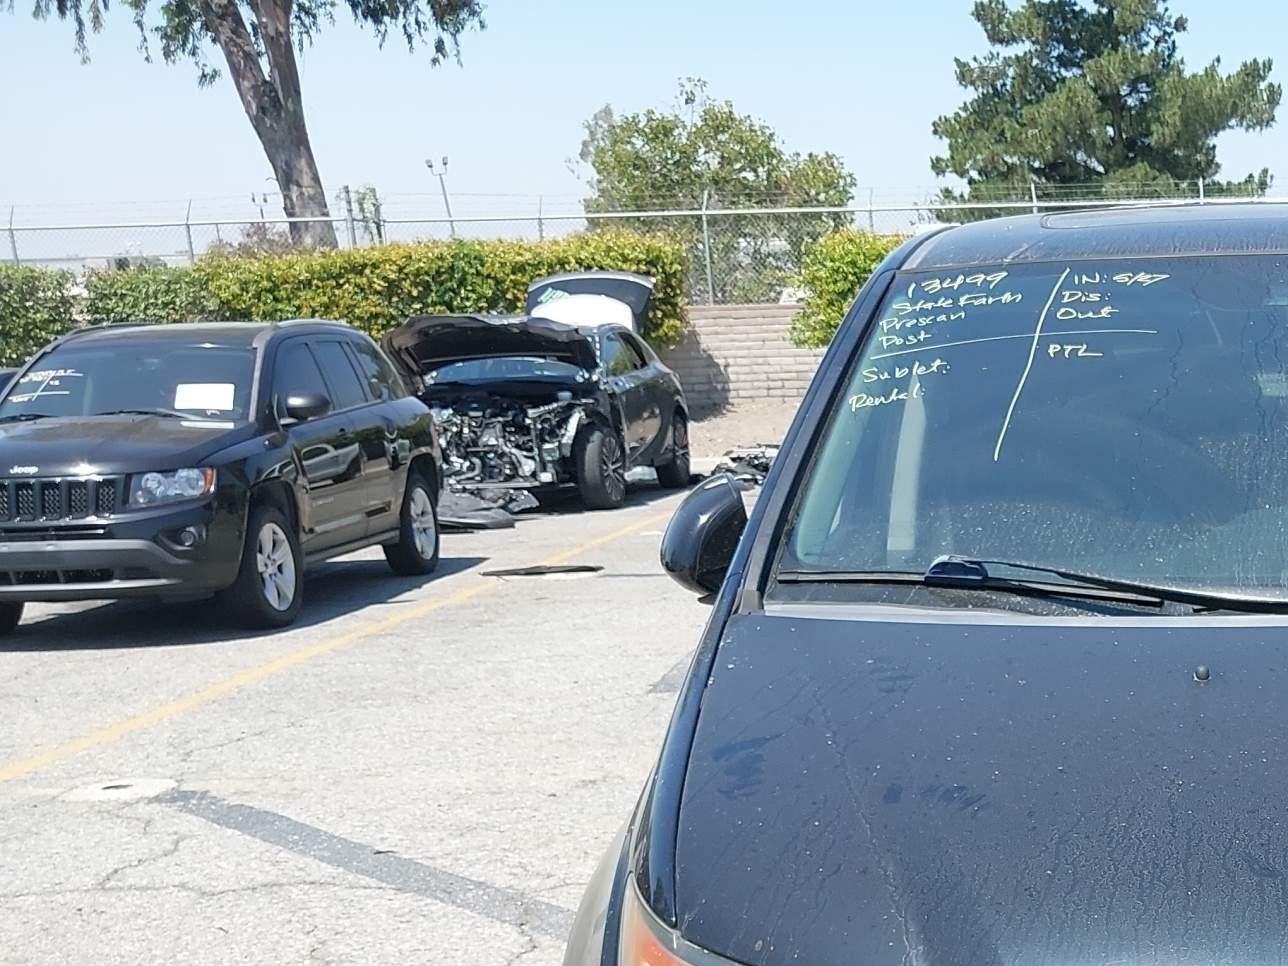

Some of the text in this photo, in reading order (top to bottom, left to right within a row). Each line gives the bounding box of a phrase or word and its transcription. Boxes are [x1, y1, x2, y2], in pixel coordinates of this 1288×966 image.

[907, 270, 1009, 299] 13499
[1074, 271, 1109, 285] IN:
[892, 298, 953, 316] State
[1056, 305, 1120, 320] Out
[879, 310, 966, 334] Prescan
[879, 330, 932, 350] Post
